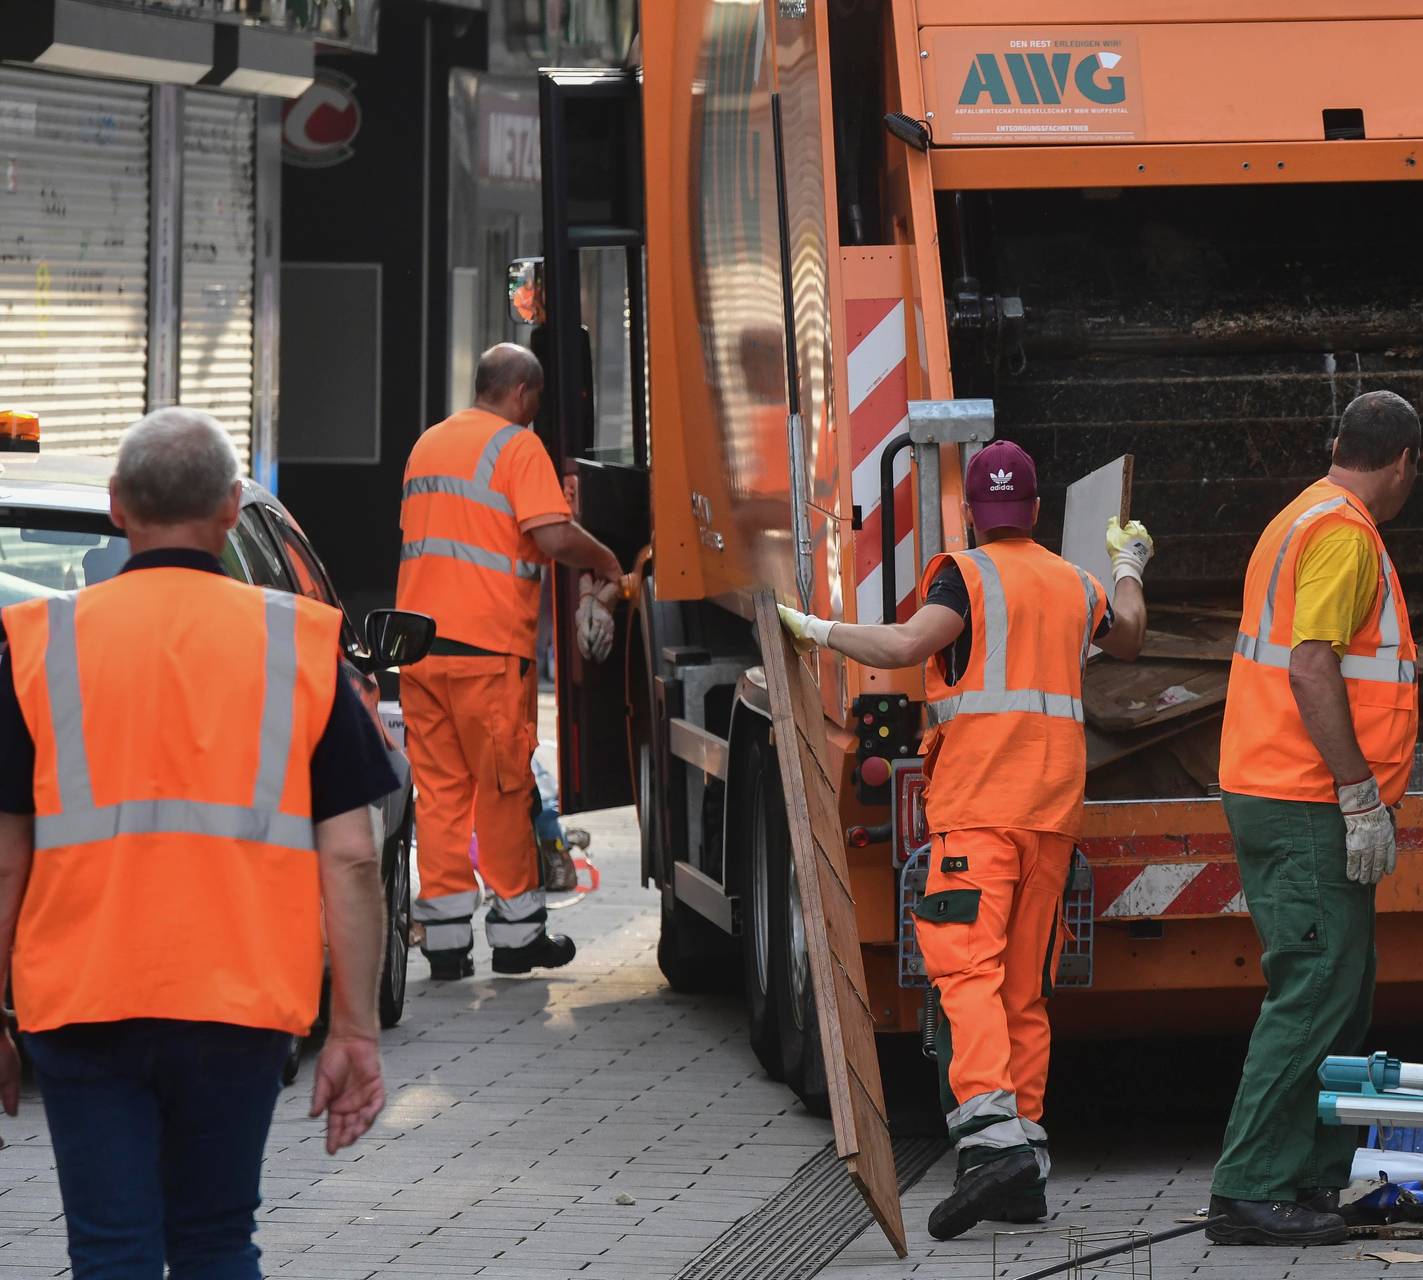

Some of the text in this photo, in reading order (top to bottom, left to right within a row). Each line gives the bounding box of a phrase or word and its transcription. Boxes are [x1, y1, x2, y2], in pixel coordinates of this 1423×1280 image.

[1010, 40, 1028, 48] DEN
[1030, 40, 1051, 48] REST
[1054, 39, 1100, 48] ERLEDIGEN
[958, 51, 1126, 105] AWG
[989, 484, 1014, 492] adidas
